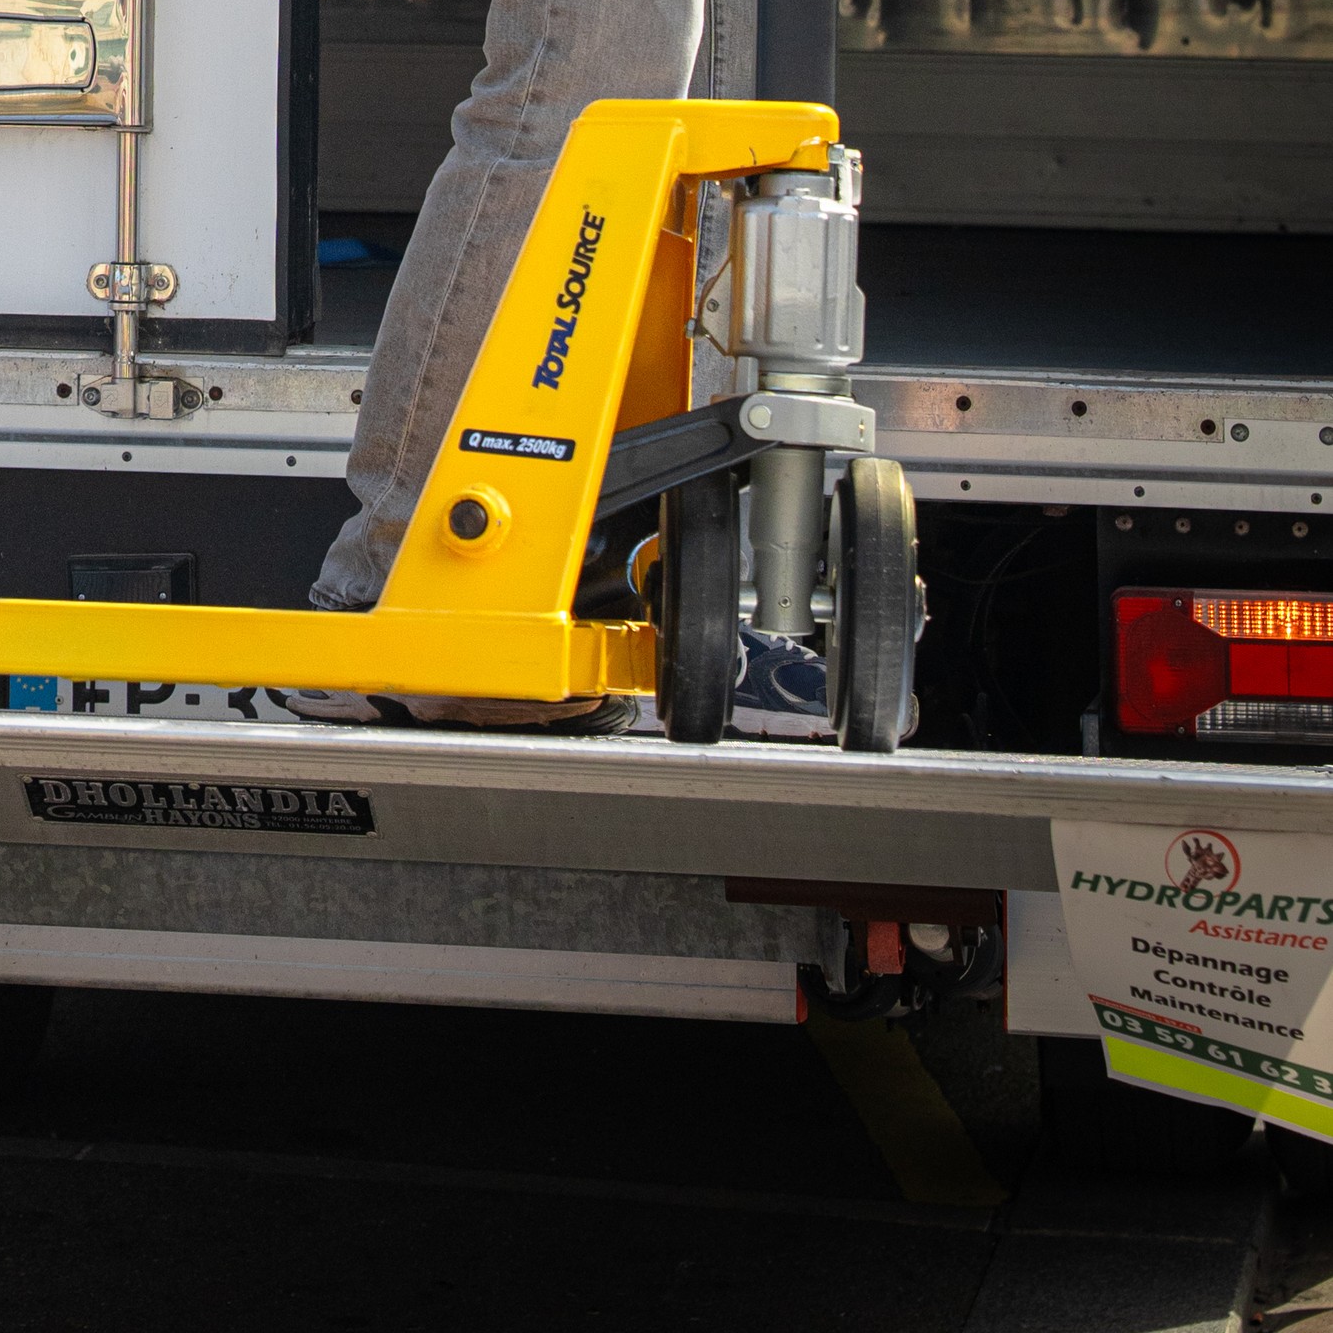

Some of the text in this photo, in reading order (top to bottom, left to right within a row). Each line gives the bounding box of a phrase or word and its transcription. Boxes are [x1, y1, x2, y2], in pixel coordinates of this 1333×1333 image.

[468, 432, 567, 459] Q max. 2500kg
[38, 779, 357, 817] DHOLLANDIA
[46, 805, 262, 829] GAMBLIN HAYONS
[1071, 870, 1333, 925] HYDROPARTS
[1188, 919, 1328, 951] Assistance
[1131, 936, 1289, 984] Dépannage
[1153, 969, 1272, 1007] Contrôle
[1129, 985, 1305, 1041] Maintenance
[1102, 1010, 1144, 1034] 03
[1155, 1025, 1194, 1051] 59
[1207, 1044, 1244, 1068] 61
[1260, 1060, 1301, 1086] 62
[1312, 1074, 1333, 1095] 3
